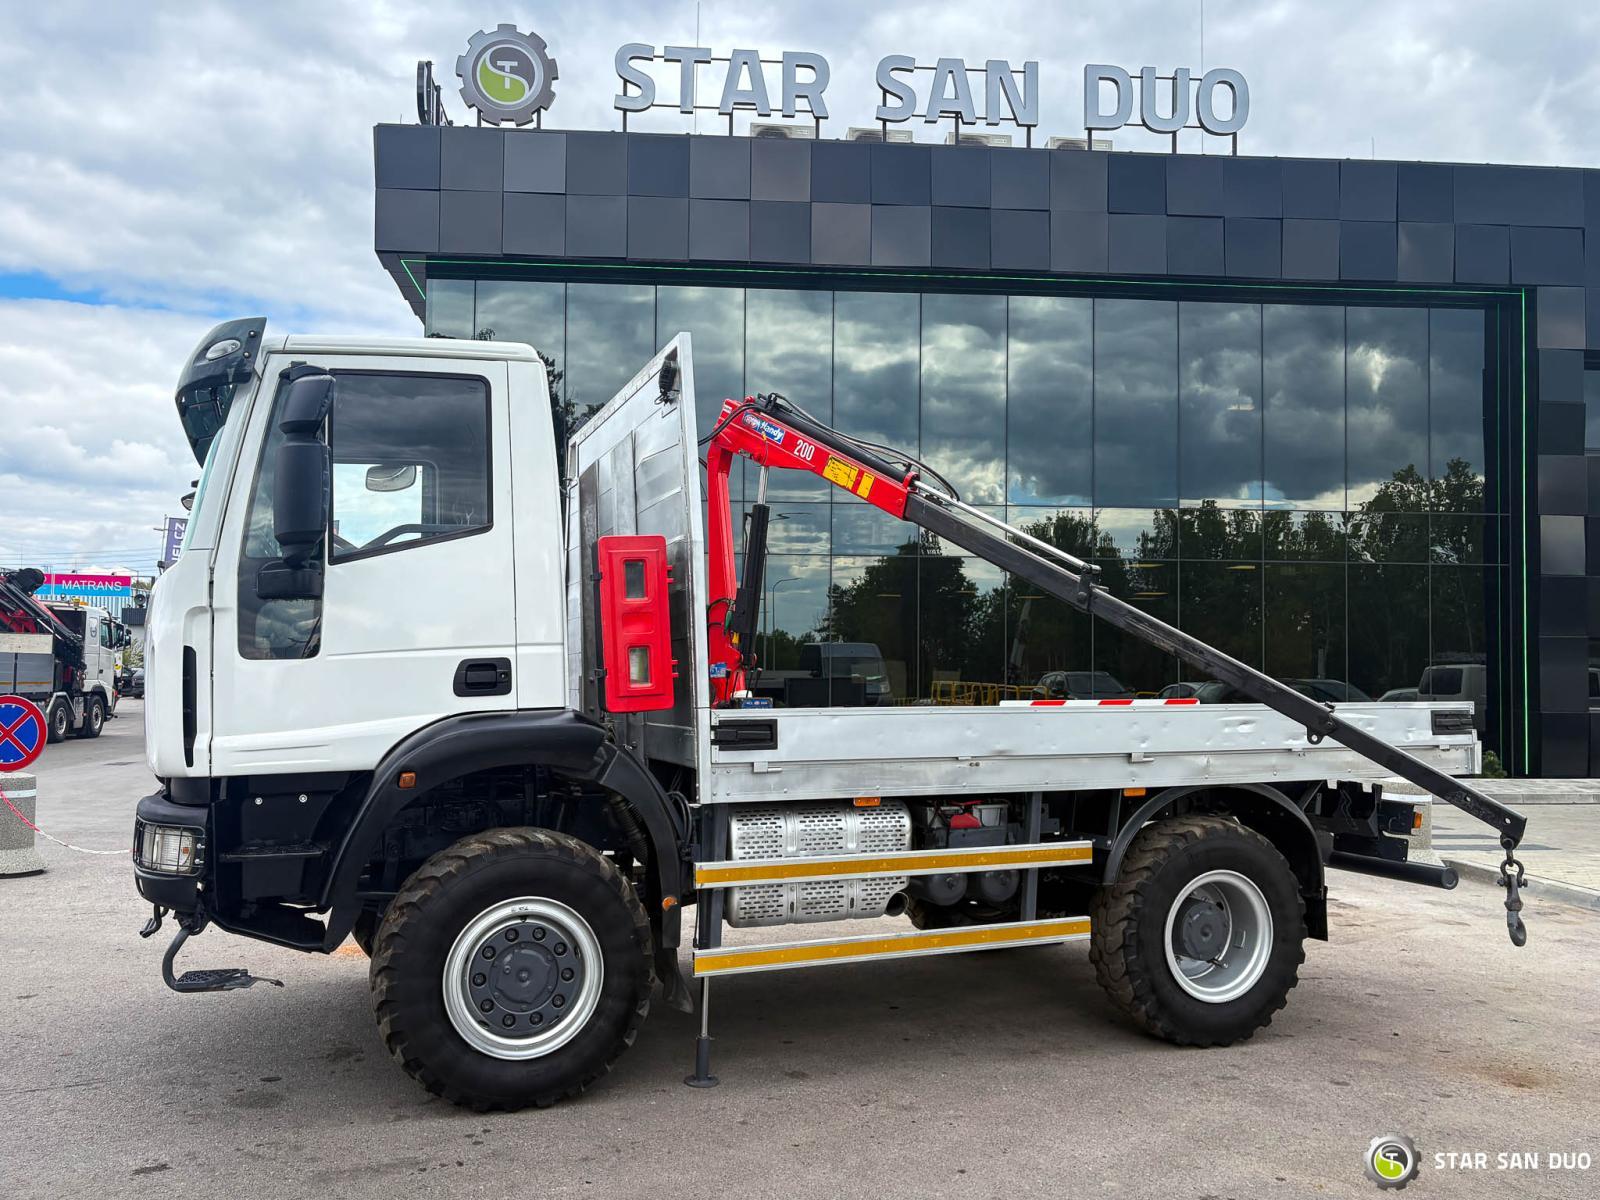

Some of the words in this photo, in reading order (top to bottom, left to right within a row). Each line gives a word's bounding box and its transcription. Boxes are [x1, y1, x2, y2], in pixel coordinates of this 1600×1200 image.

[614, 43, 831, 119] STAR
[875, 54, 1039, 127] SAN
[1084, 63, 1250, 136] DUO
[794, 439, 815, 461] 200
[61, 579, 122, 592] MATRANS
